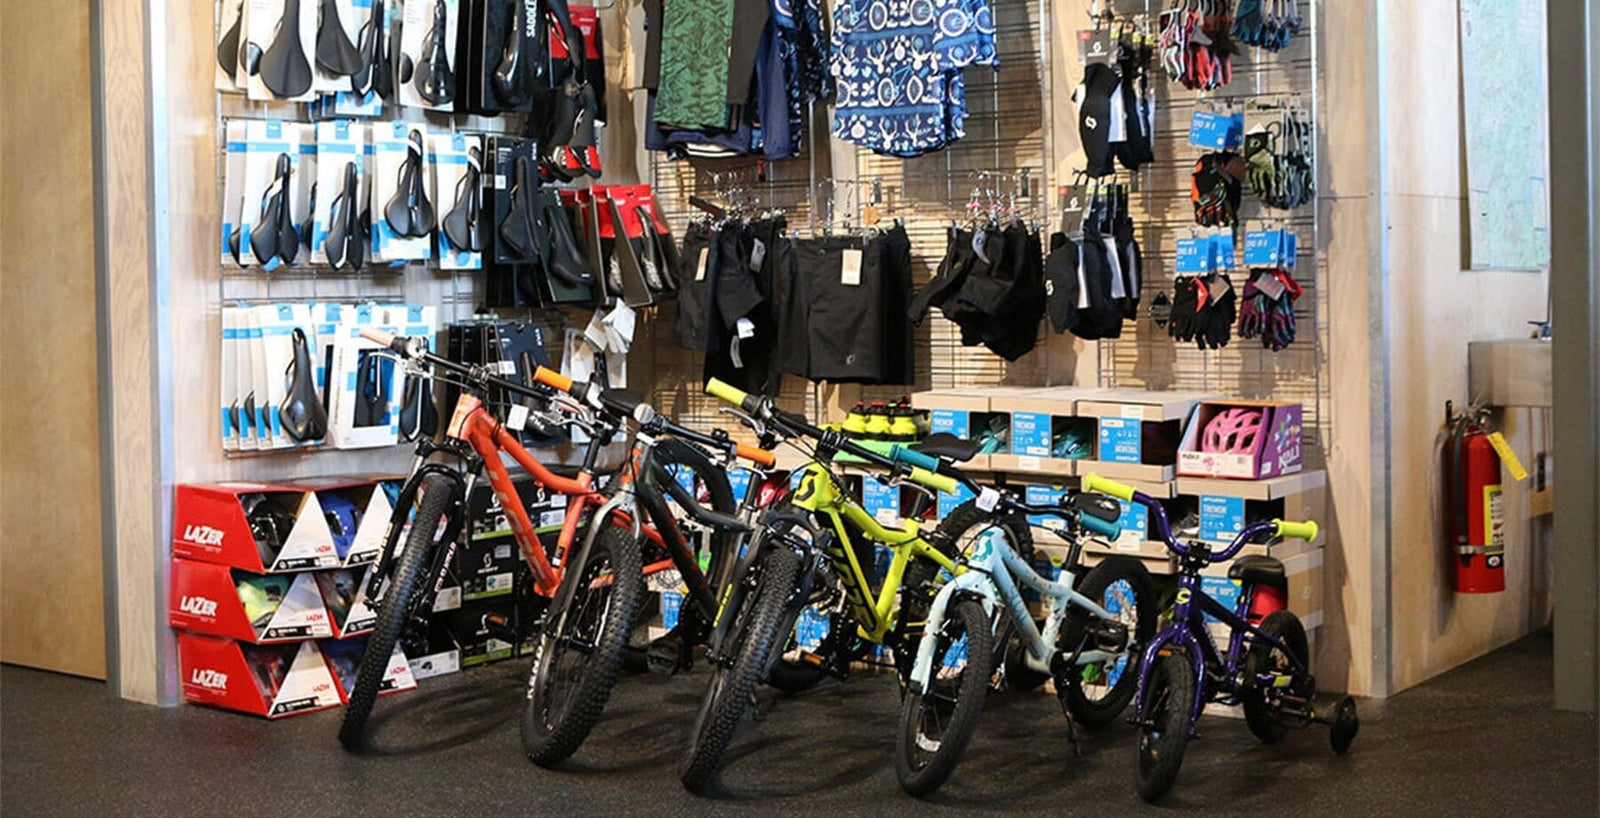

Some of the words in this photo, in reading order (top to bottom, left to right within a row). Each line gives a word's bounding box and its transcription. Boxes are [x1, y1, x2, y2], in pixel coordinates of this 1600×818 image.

[183, 525, 224, 546] LAZER
[180, 596, 217, 616] LAZER
[192, 668, 228, 689] LAZER
